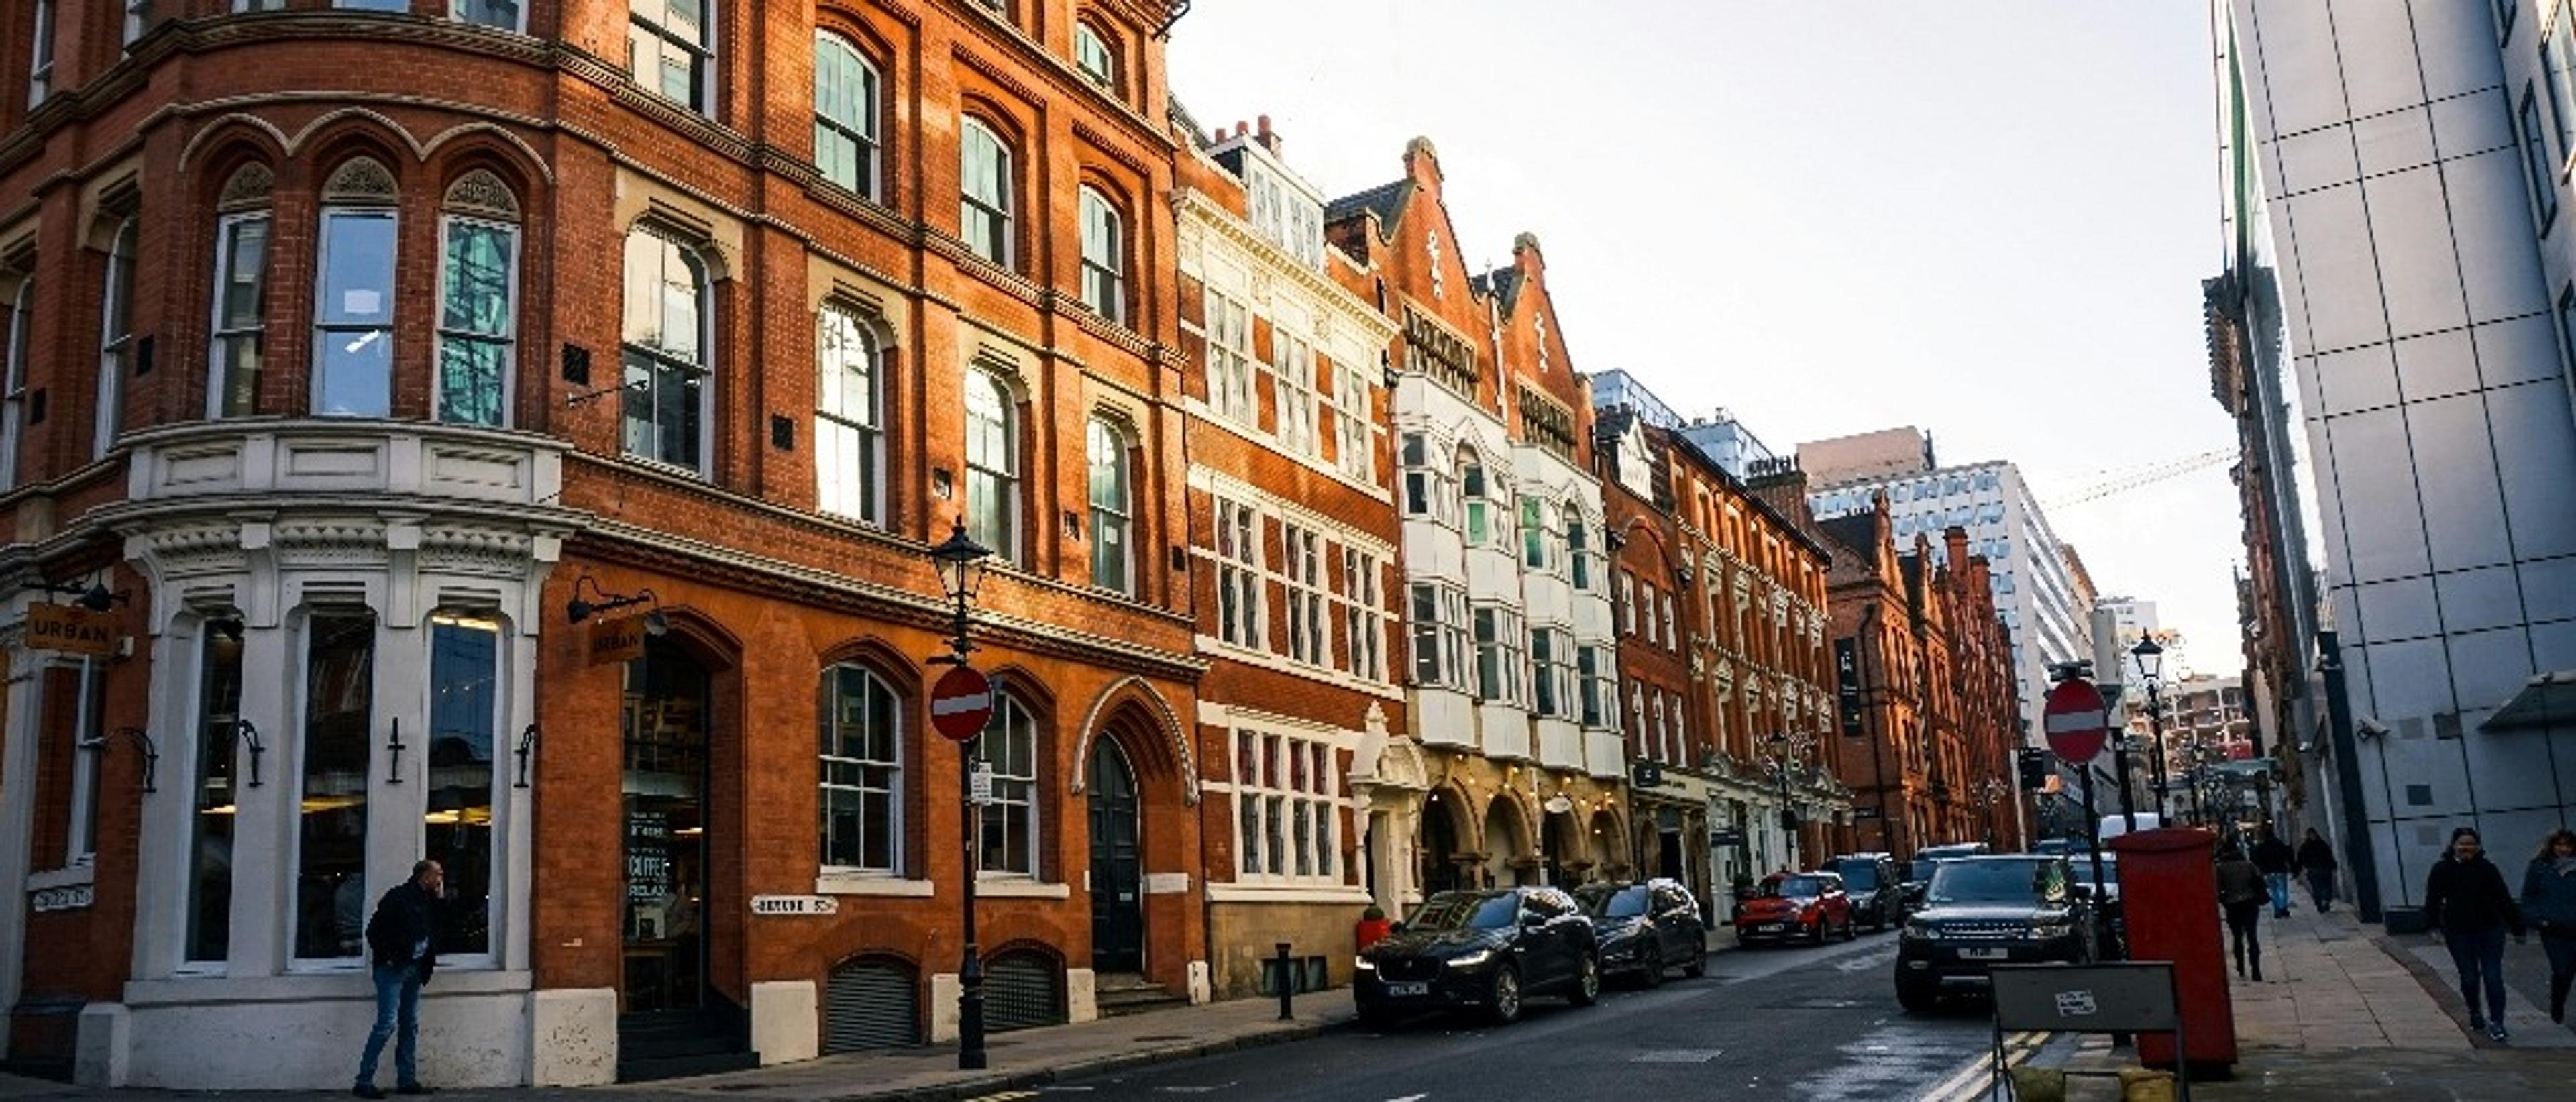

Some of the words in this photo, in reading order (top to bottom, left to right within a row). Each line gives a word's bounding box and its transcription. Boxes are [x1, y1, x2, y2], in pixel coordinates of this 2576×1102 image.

[34, 618, 109, 643] URBAN
[593, 632, 638, 653] URBAN
[629, 856, 667, 877] COFFEE
[629, 885, 667, 897] RELAX
